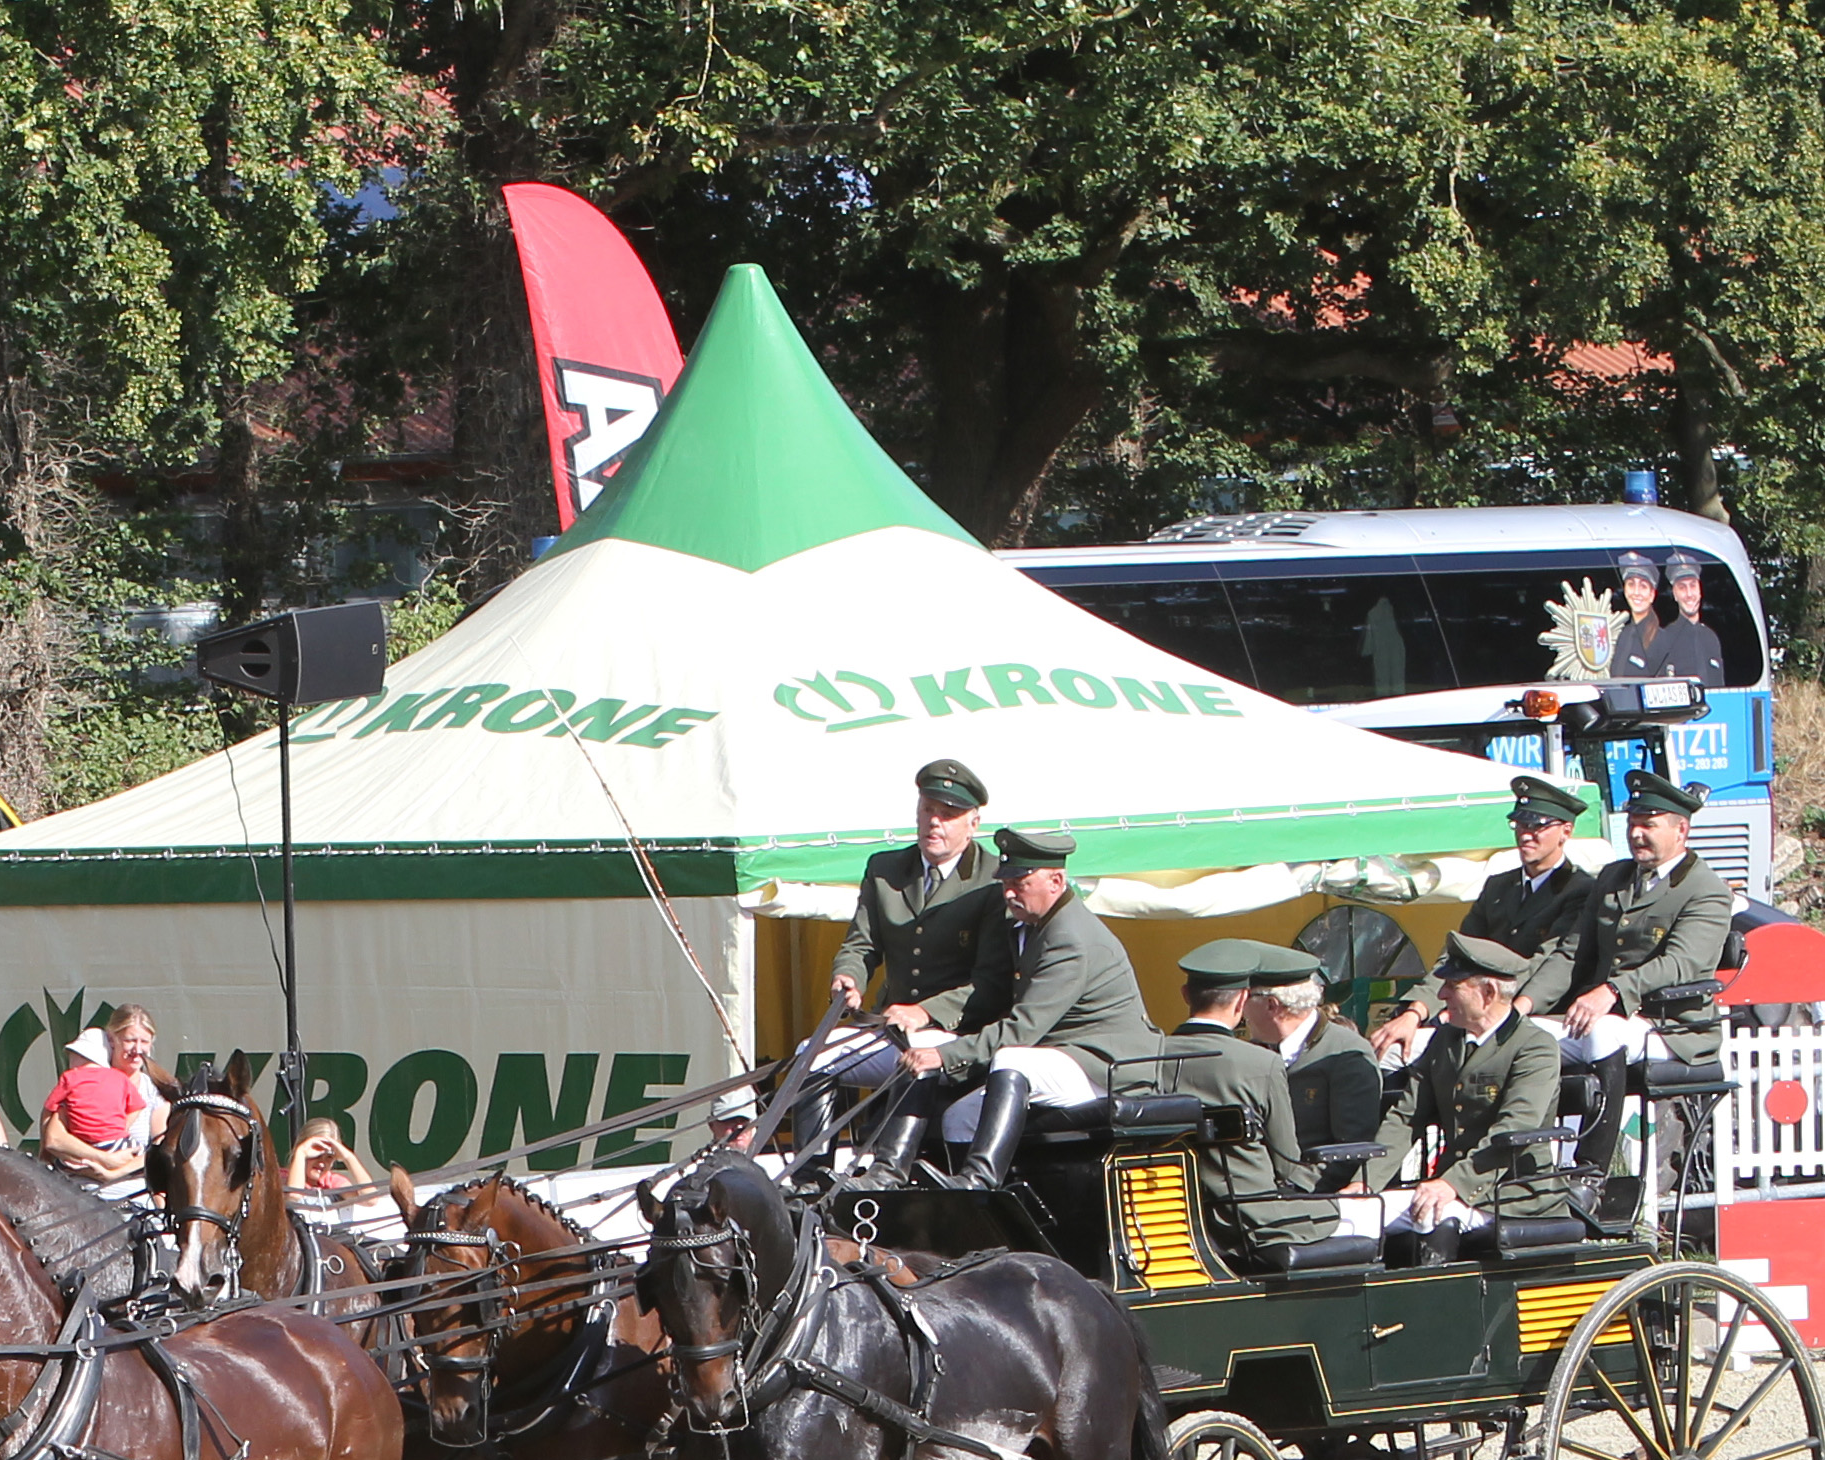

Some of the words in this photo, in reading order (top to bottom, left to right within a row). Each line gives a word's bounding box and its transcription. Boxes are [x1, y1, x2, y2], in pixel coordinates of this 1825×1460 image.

[553, 357, 663, 516] A
[350, 682, 721, 749] KRONE
[909, 662, 1245, 718] KRONE
[1491, 734, 1543, 764] WIR
[1668, 723, 1729, 757] TZT!
